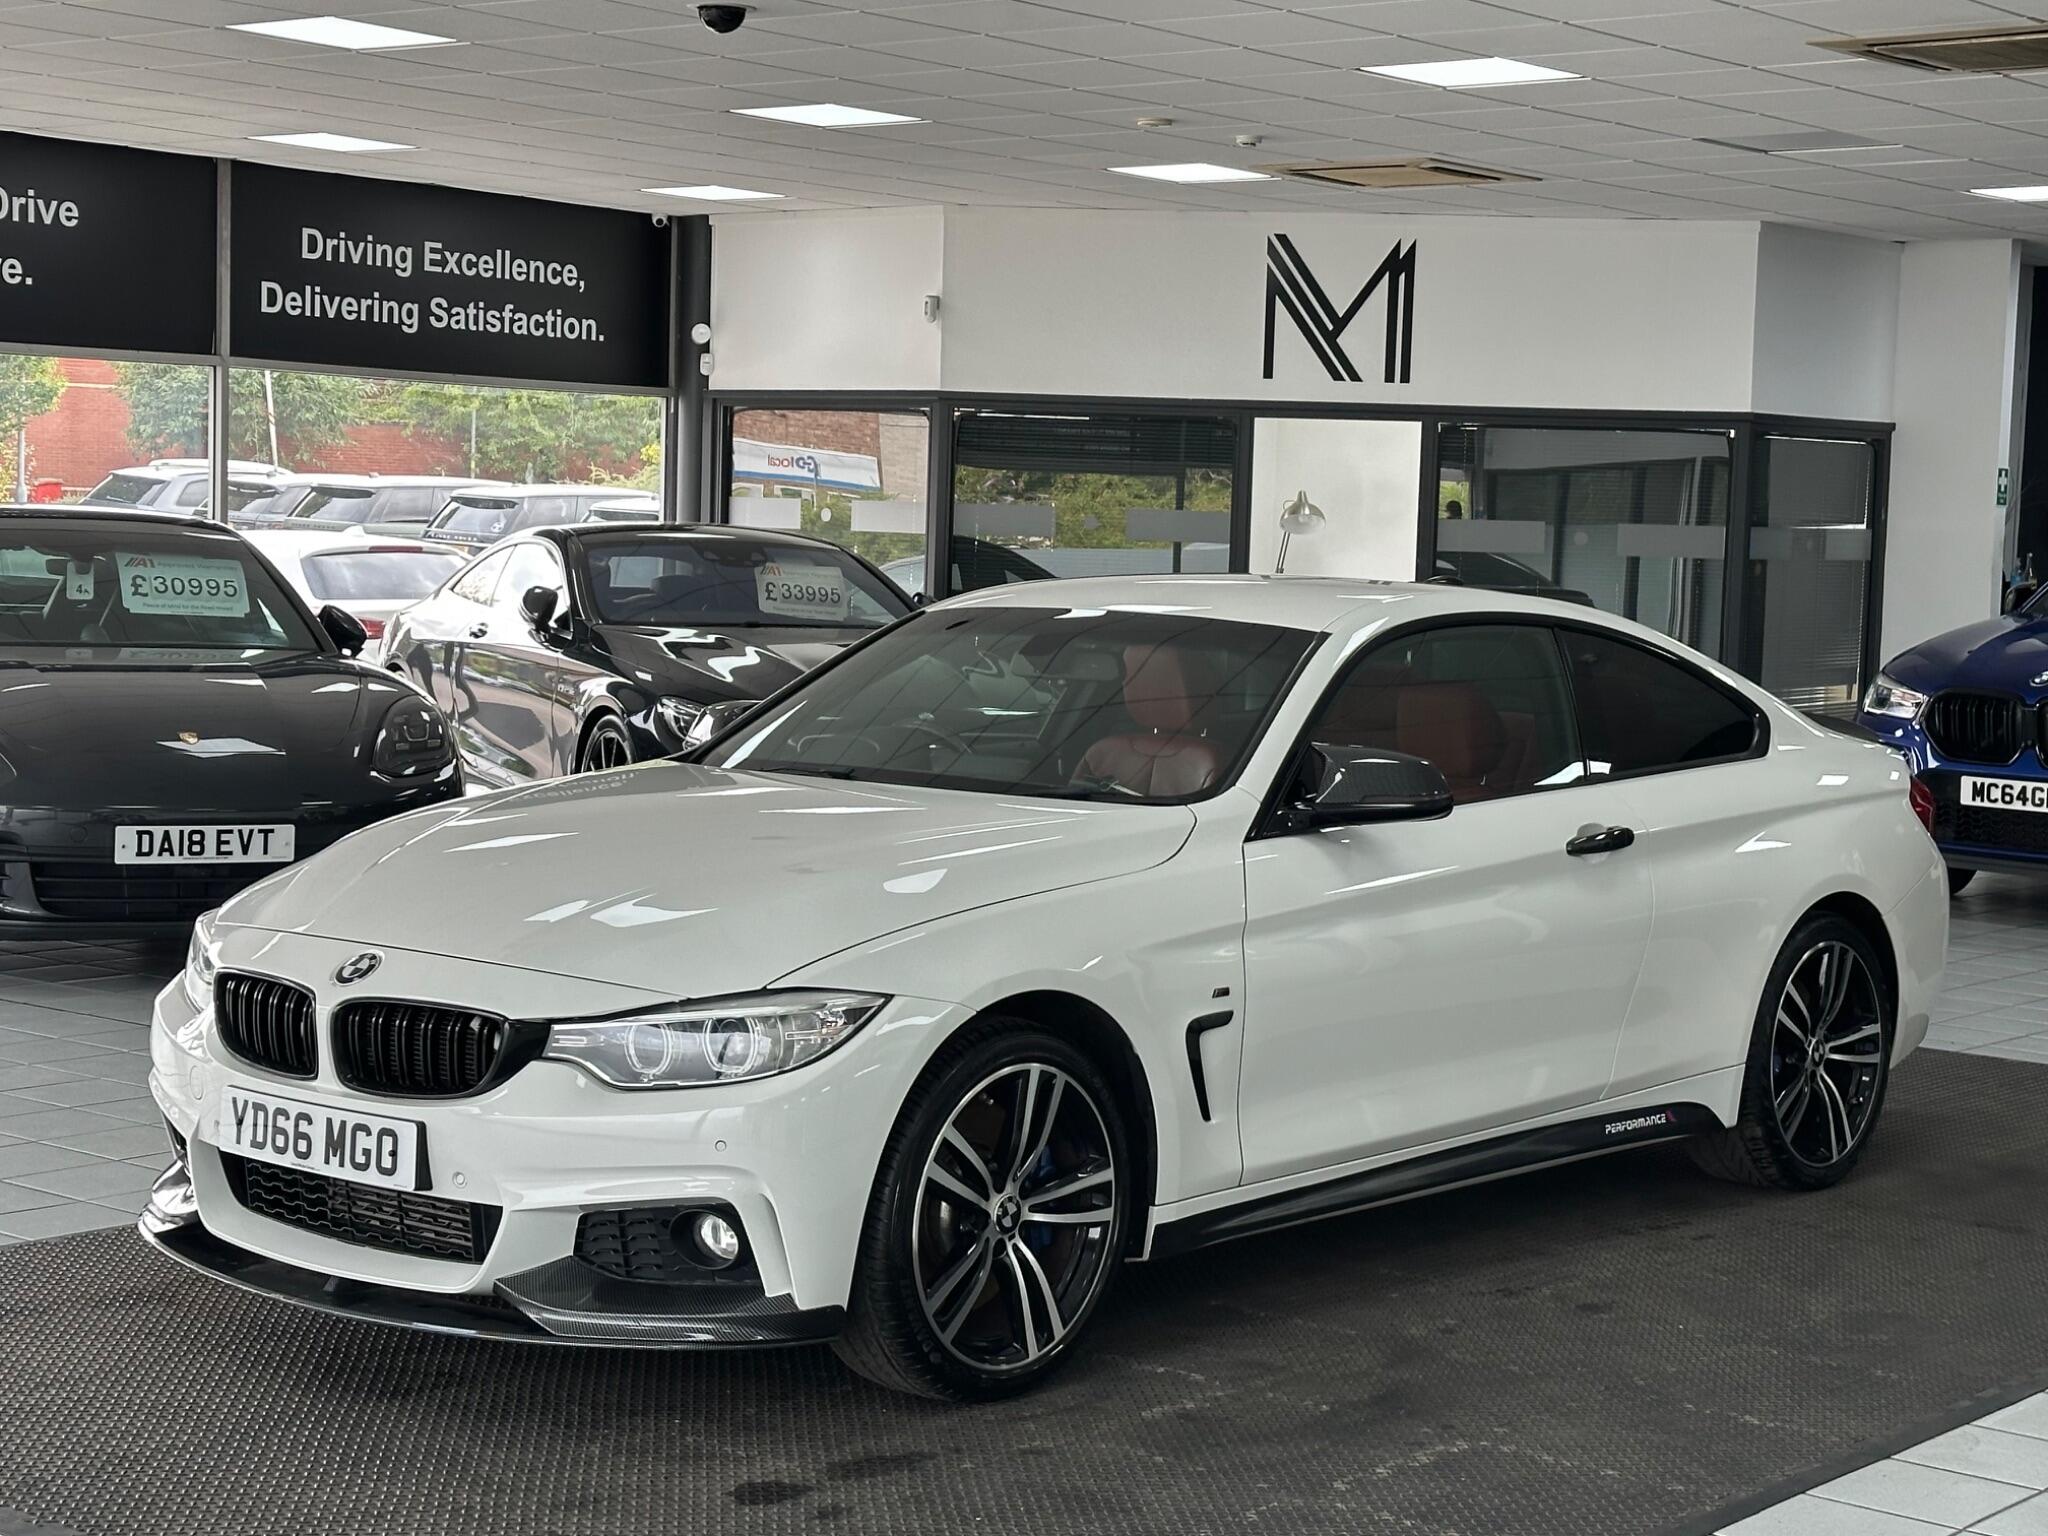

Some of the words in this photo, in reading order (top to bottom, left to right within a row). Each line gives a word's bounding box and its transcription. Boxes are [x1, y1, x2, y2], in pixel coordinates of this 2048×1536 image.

[301, 227, 412, 277] Driving
[423, 241, 585, 293] Excellence,
[260, 281, 418, 334] Delivering
[429, 297, 605, 342] Satisfaction.
[130, 574, 238, 598] £30995
[765, 582, 841, 604] £33995
[1971, 780, 2048, 809] MC64G
[135, 829, 206, 857] DA18
[215, 828, 275, 856] EVT
[231, 1096, 314, 1160] YD66
[323, 1116, 399, 1177] MGO
[1605, 1113, 1667, 1135] PERFORMANCE
